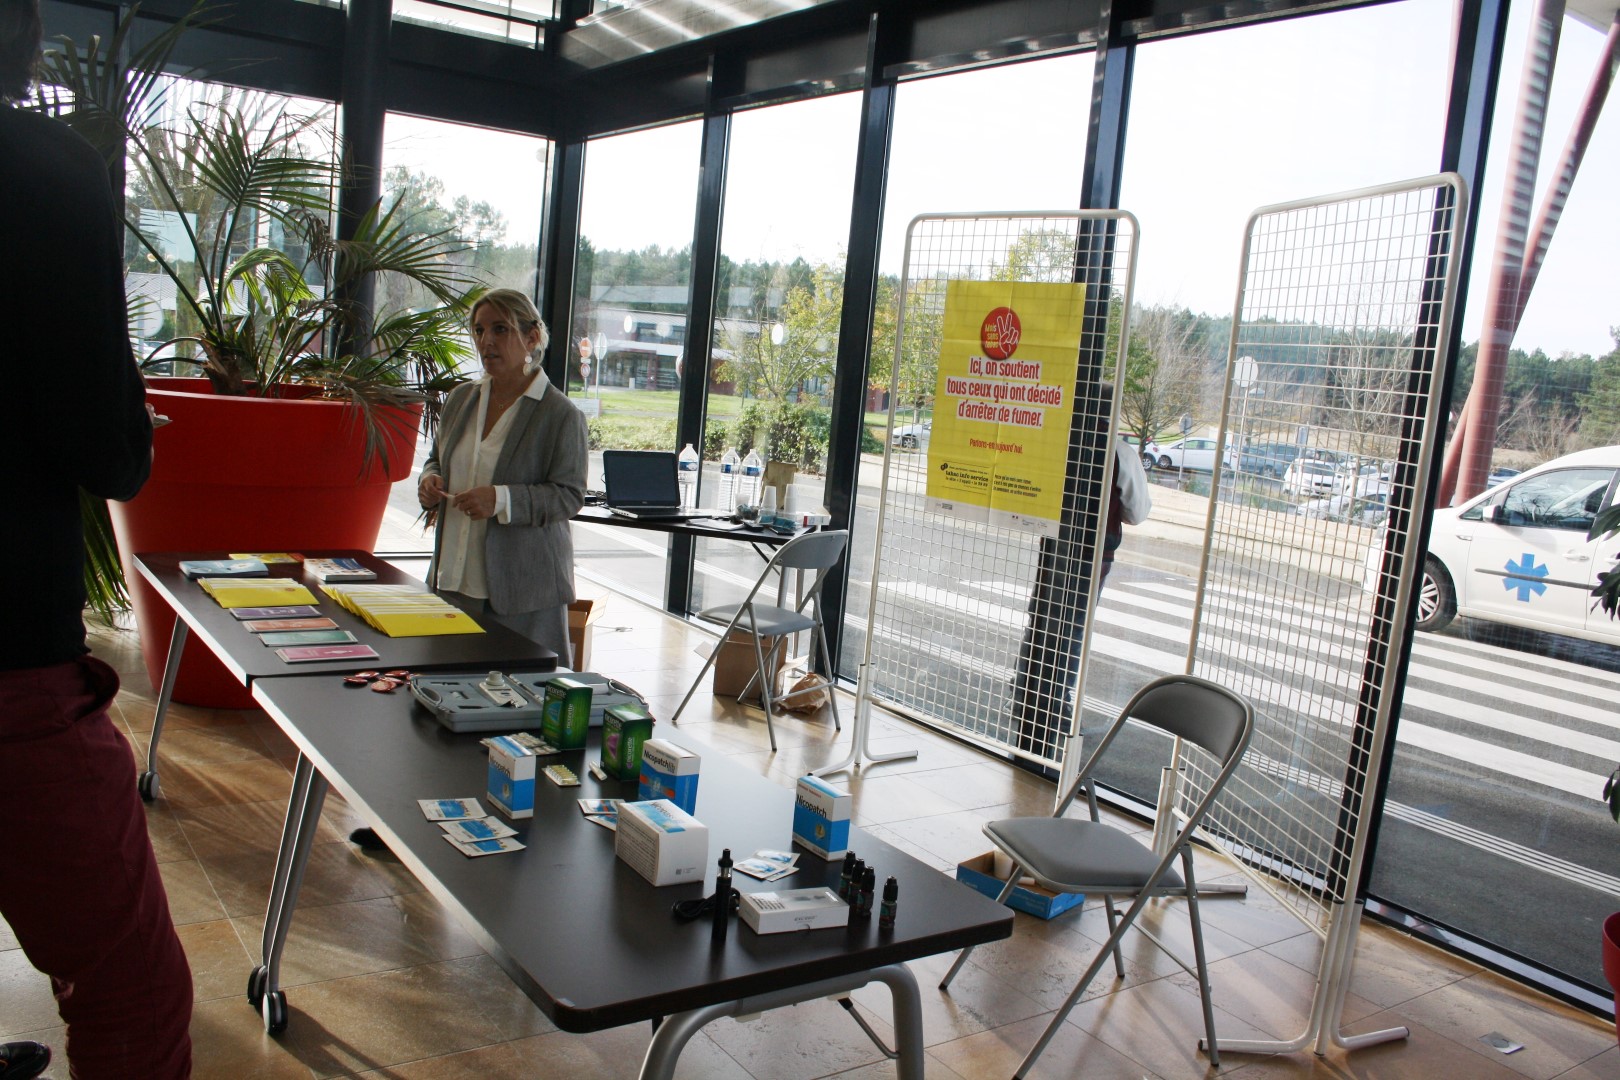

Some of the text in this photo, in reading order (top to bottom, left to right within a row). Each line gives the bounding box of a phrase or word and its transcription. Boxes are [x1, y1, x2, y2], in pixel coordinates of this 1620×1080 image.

[969, 357, 1040, 379] Ici, on soutient
[947, 378, 1061, 405] tous ceux qui ont décidé
[958, 399, 1042, 427] d'arrêter de fumer.
[796, 794, 827, 819] Nicopatch
